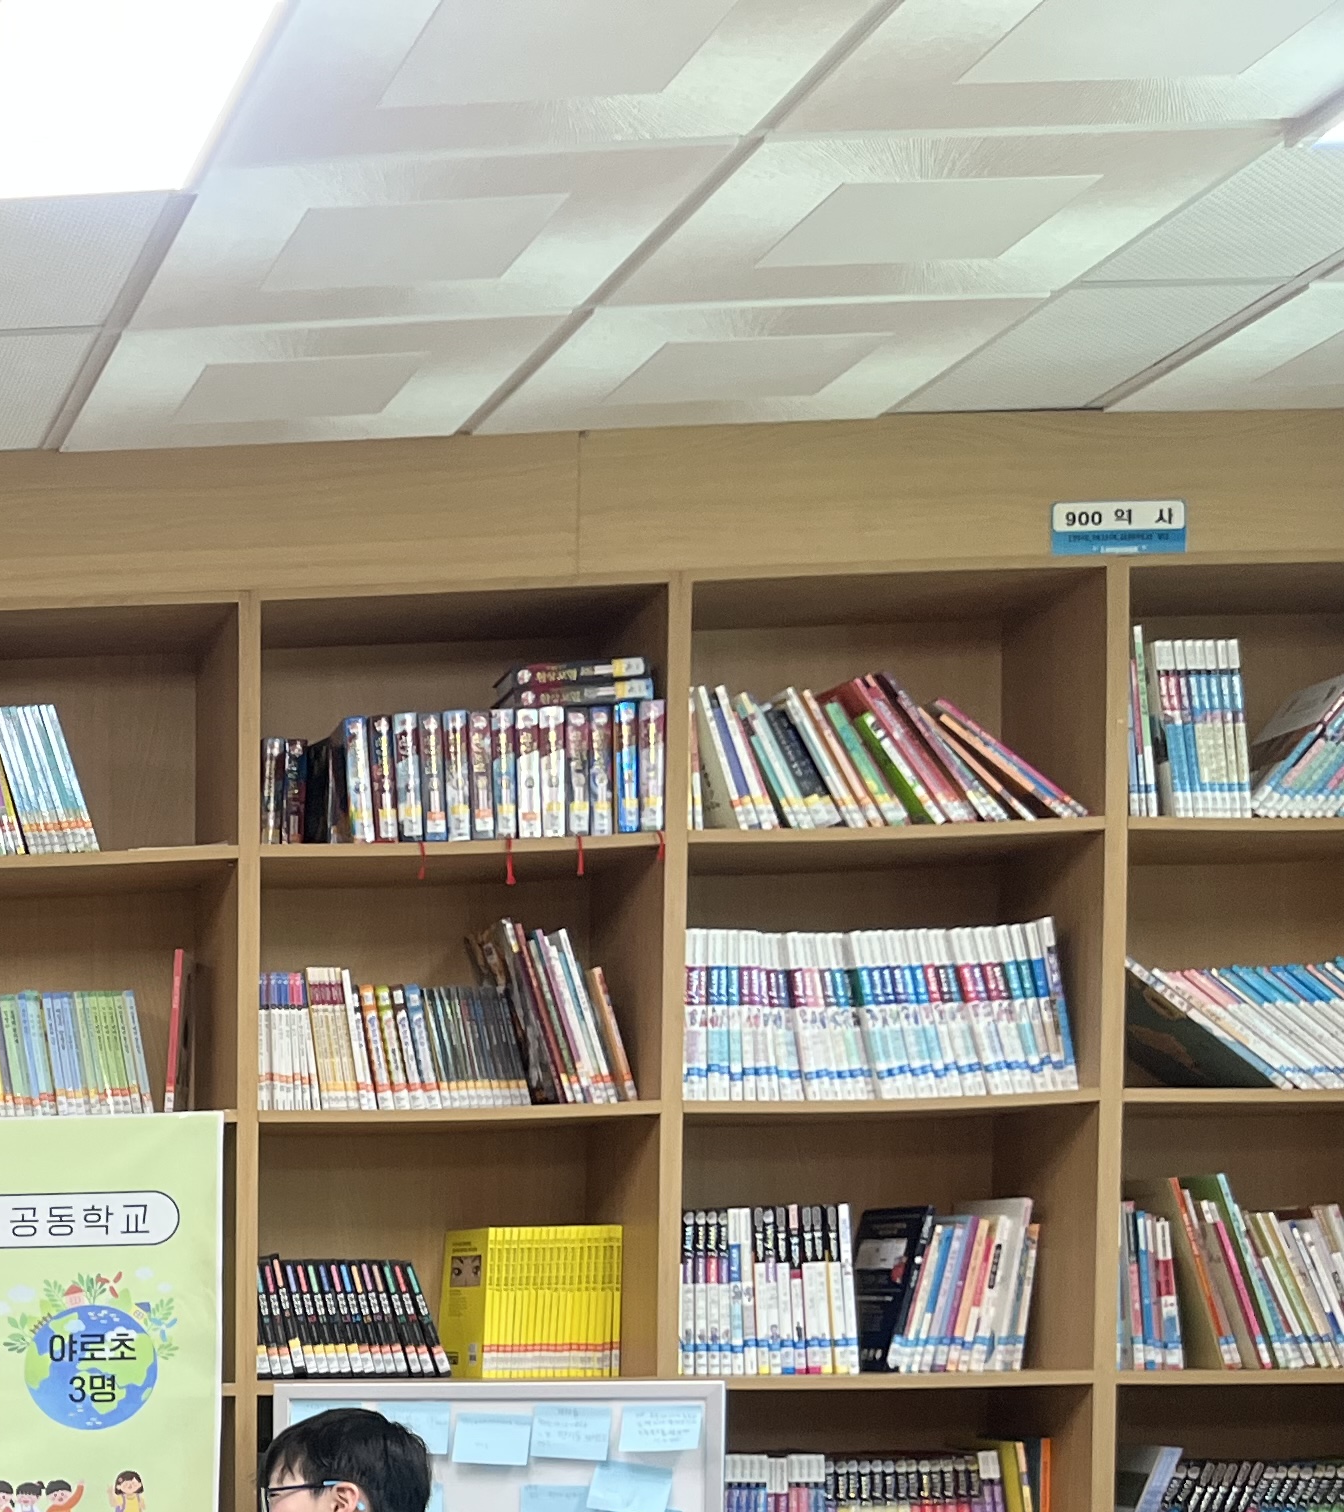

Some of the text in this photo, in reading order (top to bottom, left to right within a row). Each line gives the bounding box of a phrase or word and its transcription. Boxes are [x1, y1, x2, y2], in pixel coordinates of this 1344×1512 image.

[1065, 511, 1103, 527] 900
[1155, 507, 1174, 526] 사
[9, 1204, 150, 1238] 공동학교
[49, 1333, 137, 1363] 야로초
[68, 1374, 116, 1403] 3명
